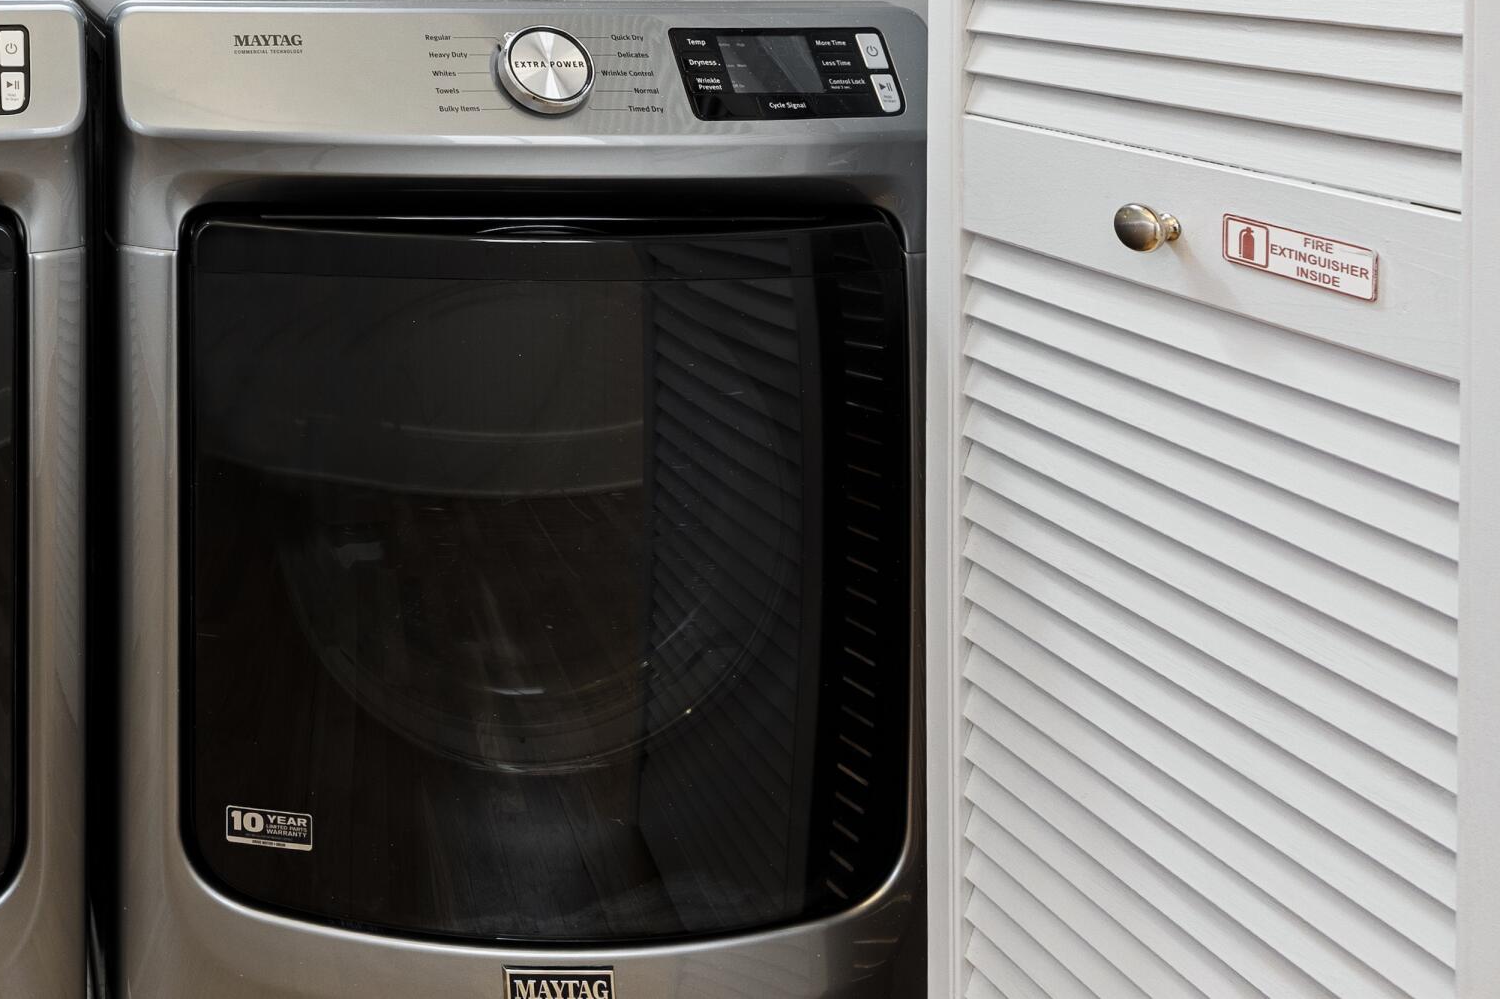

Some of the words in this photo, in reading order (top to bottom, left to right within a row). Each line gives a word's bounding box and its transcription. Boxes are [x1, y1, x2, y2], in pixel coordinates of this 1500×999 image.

[233, 34, 303, 47] MAYTAG
[425, 34, 451, 42] Regular
[686, 38, 706, 47] Temp
[689, 59, 717, 67] Dryness
[786, 102, 807, 110] Signal
[1303, 237, 1334, 255] FIRE
[1270, 243, 1370, 280] EXTINGUISHER
[1296, 266, 1341, 288] INSIDE
[231, 810, 264, 833] 10
[267, 814, 307, 827] YEAR
[266, 829, 307, 838] WARRANTY
[513, 979, 610, 999] MAYTAG
